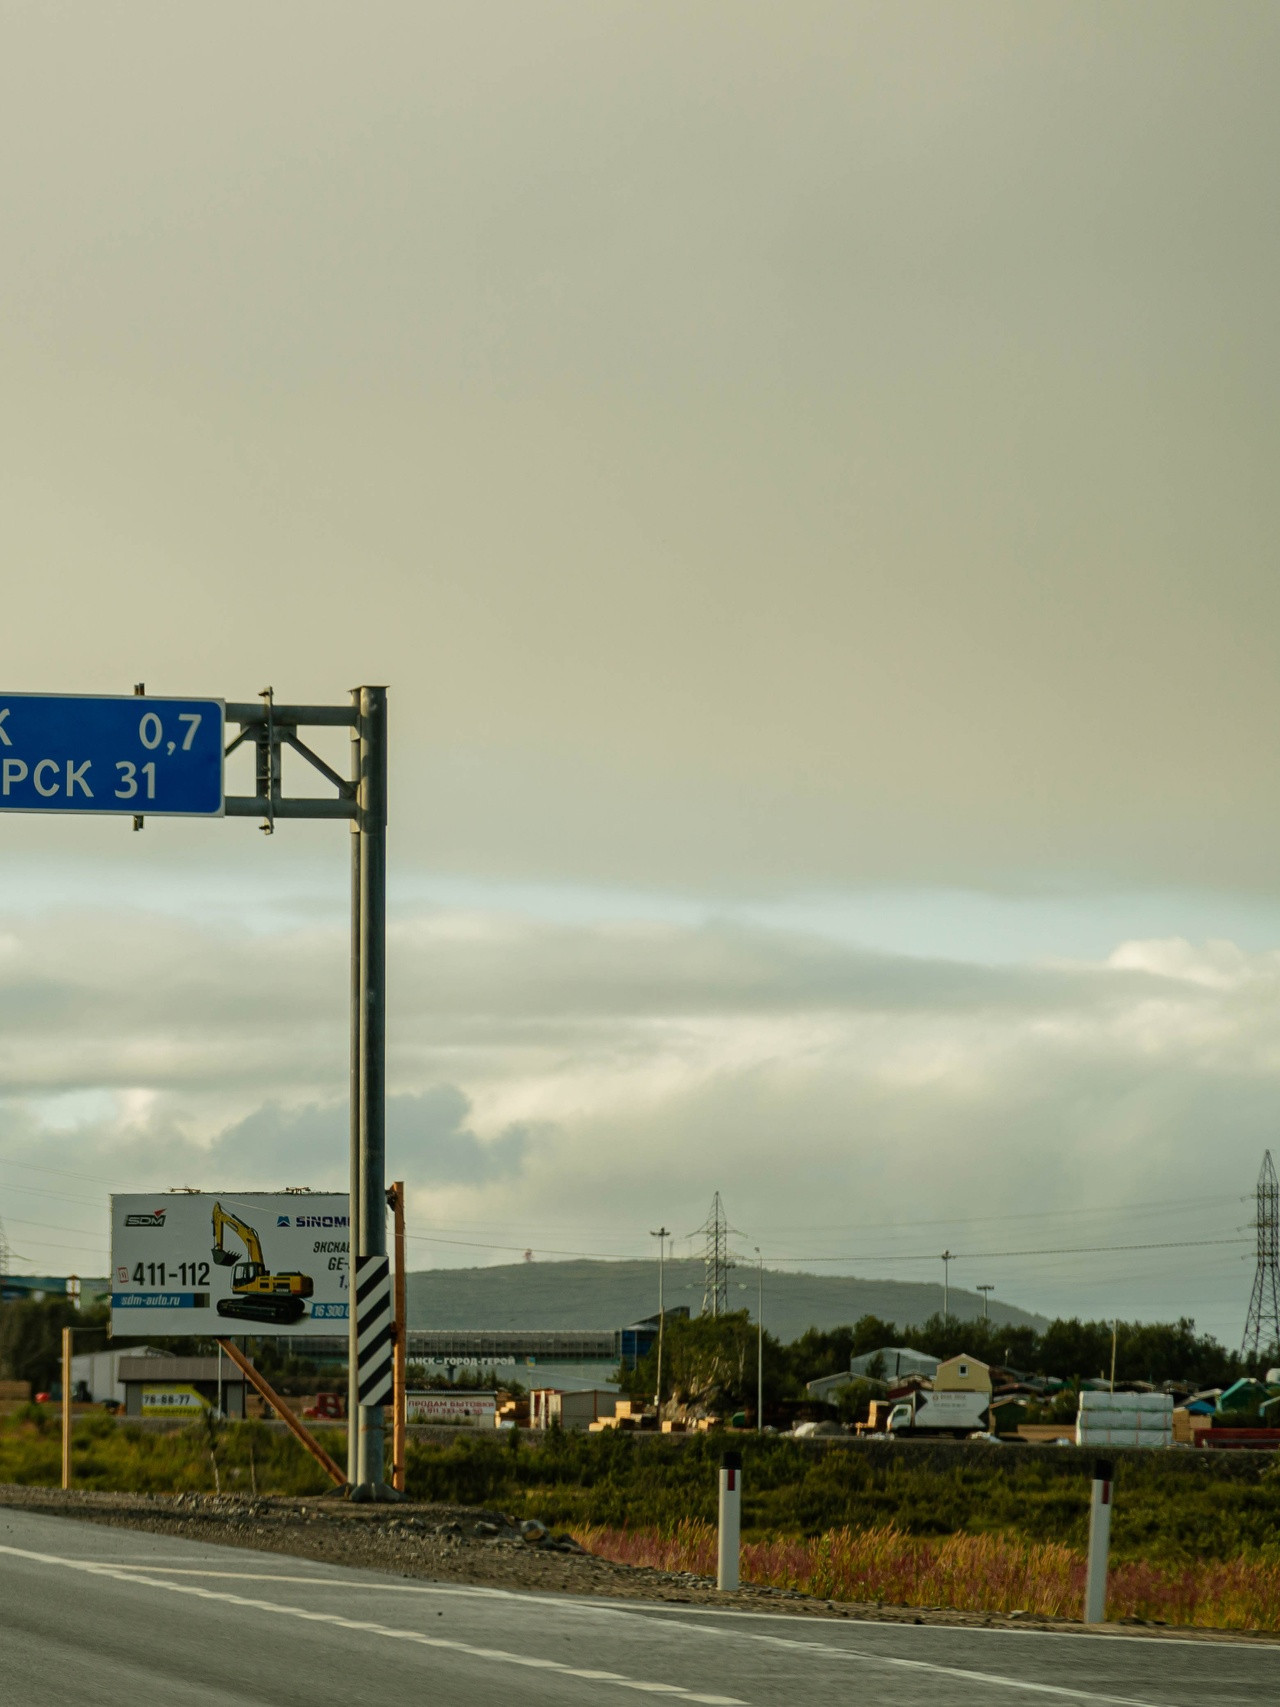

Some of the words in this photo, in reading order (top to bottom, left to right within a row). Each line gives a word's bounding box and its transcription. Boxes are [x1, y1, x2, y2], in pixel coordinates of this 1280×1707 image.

[138, 712, 203, 756] 0,7
[114, 761, 156, 799] 31
[127, 1216, 164, 1225] SDM
[328, 1257, 350, 1271] GE-
[133, 1262, 210, 1286] 411-112
[121, 1294, 181, 1306] sdm-auto.ru
[408, 1400, 447, 1408] ПРОДАМ
